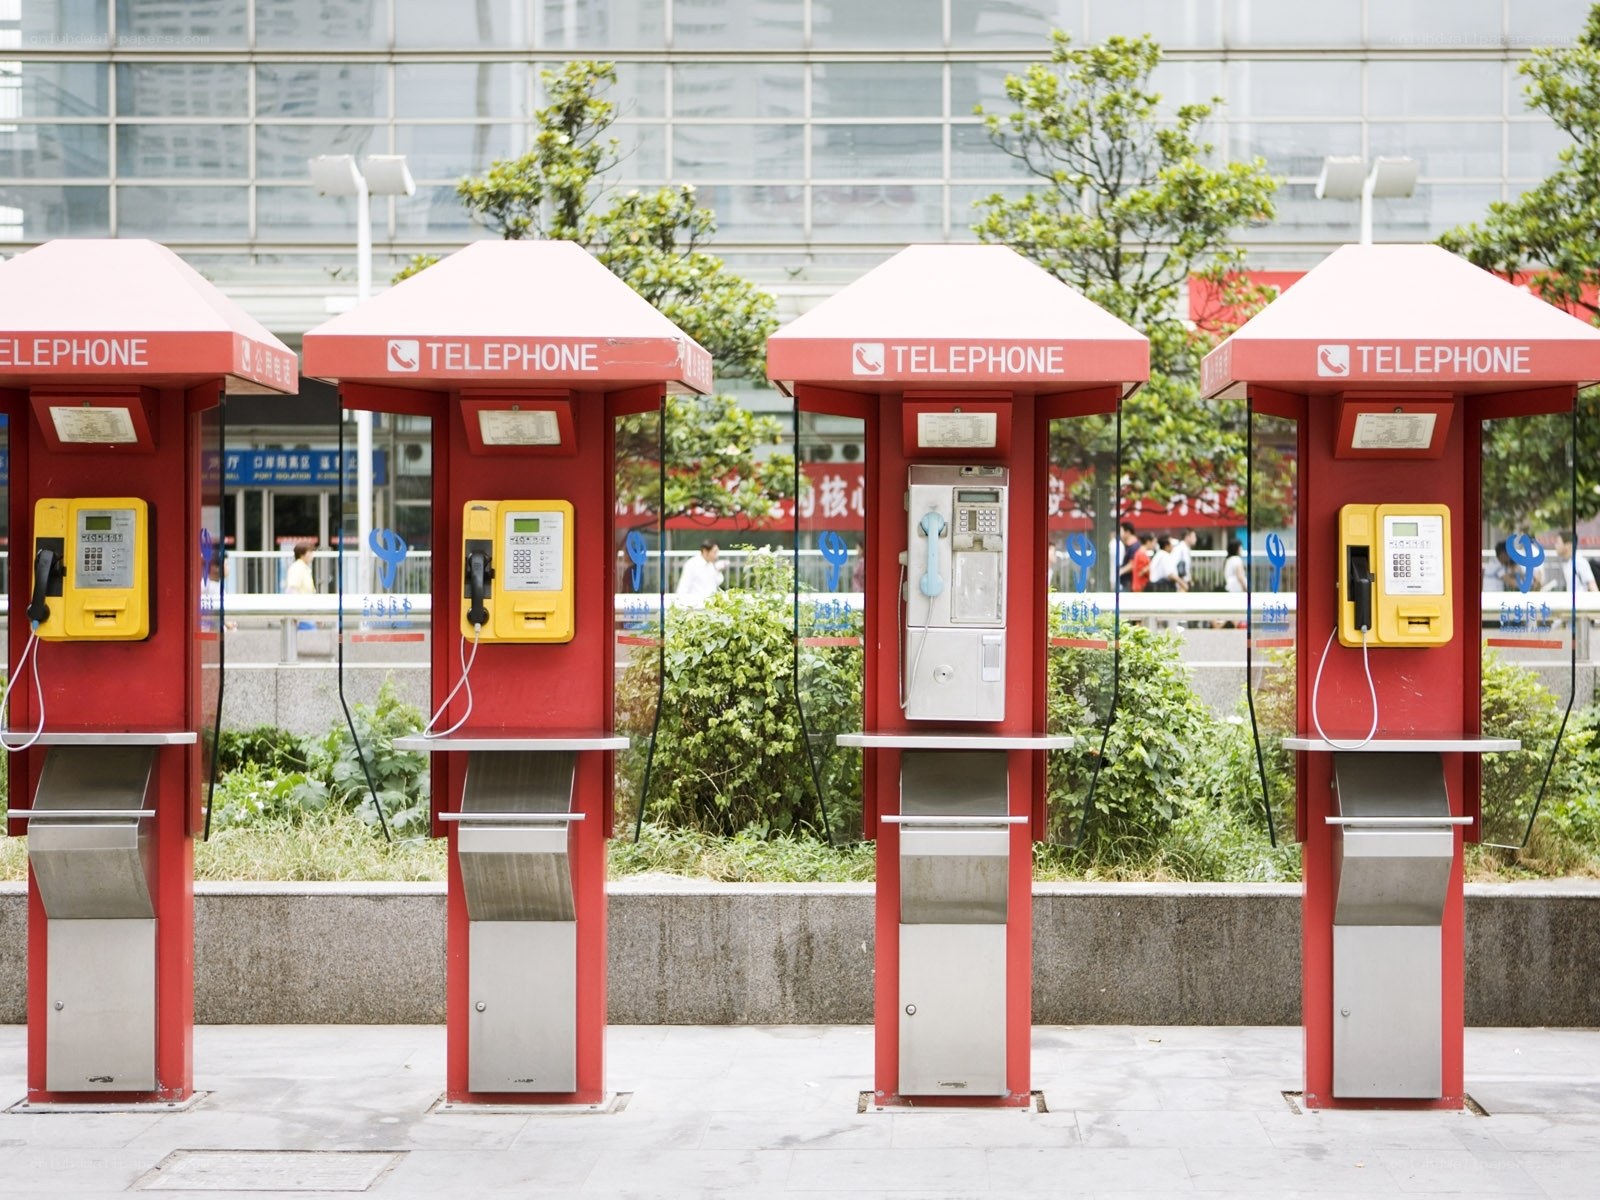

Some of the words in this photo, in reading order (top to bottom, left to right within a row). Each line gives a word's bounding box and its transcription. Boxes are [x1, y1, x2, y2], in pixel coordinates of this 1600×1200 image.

[0, 339, 148, 366] ELEPHONE
[427, 343, 598, 371] TELEPHONE
[891, 346, 1064, 373] TELEPHONE
[1357, 346, 1531, 373] TELEPHONE
[255, 349, 291, 385] 公用电话
